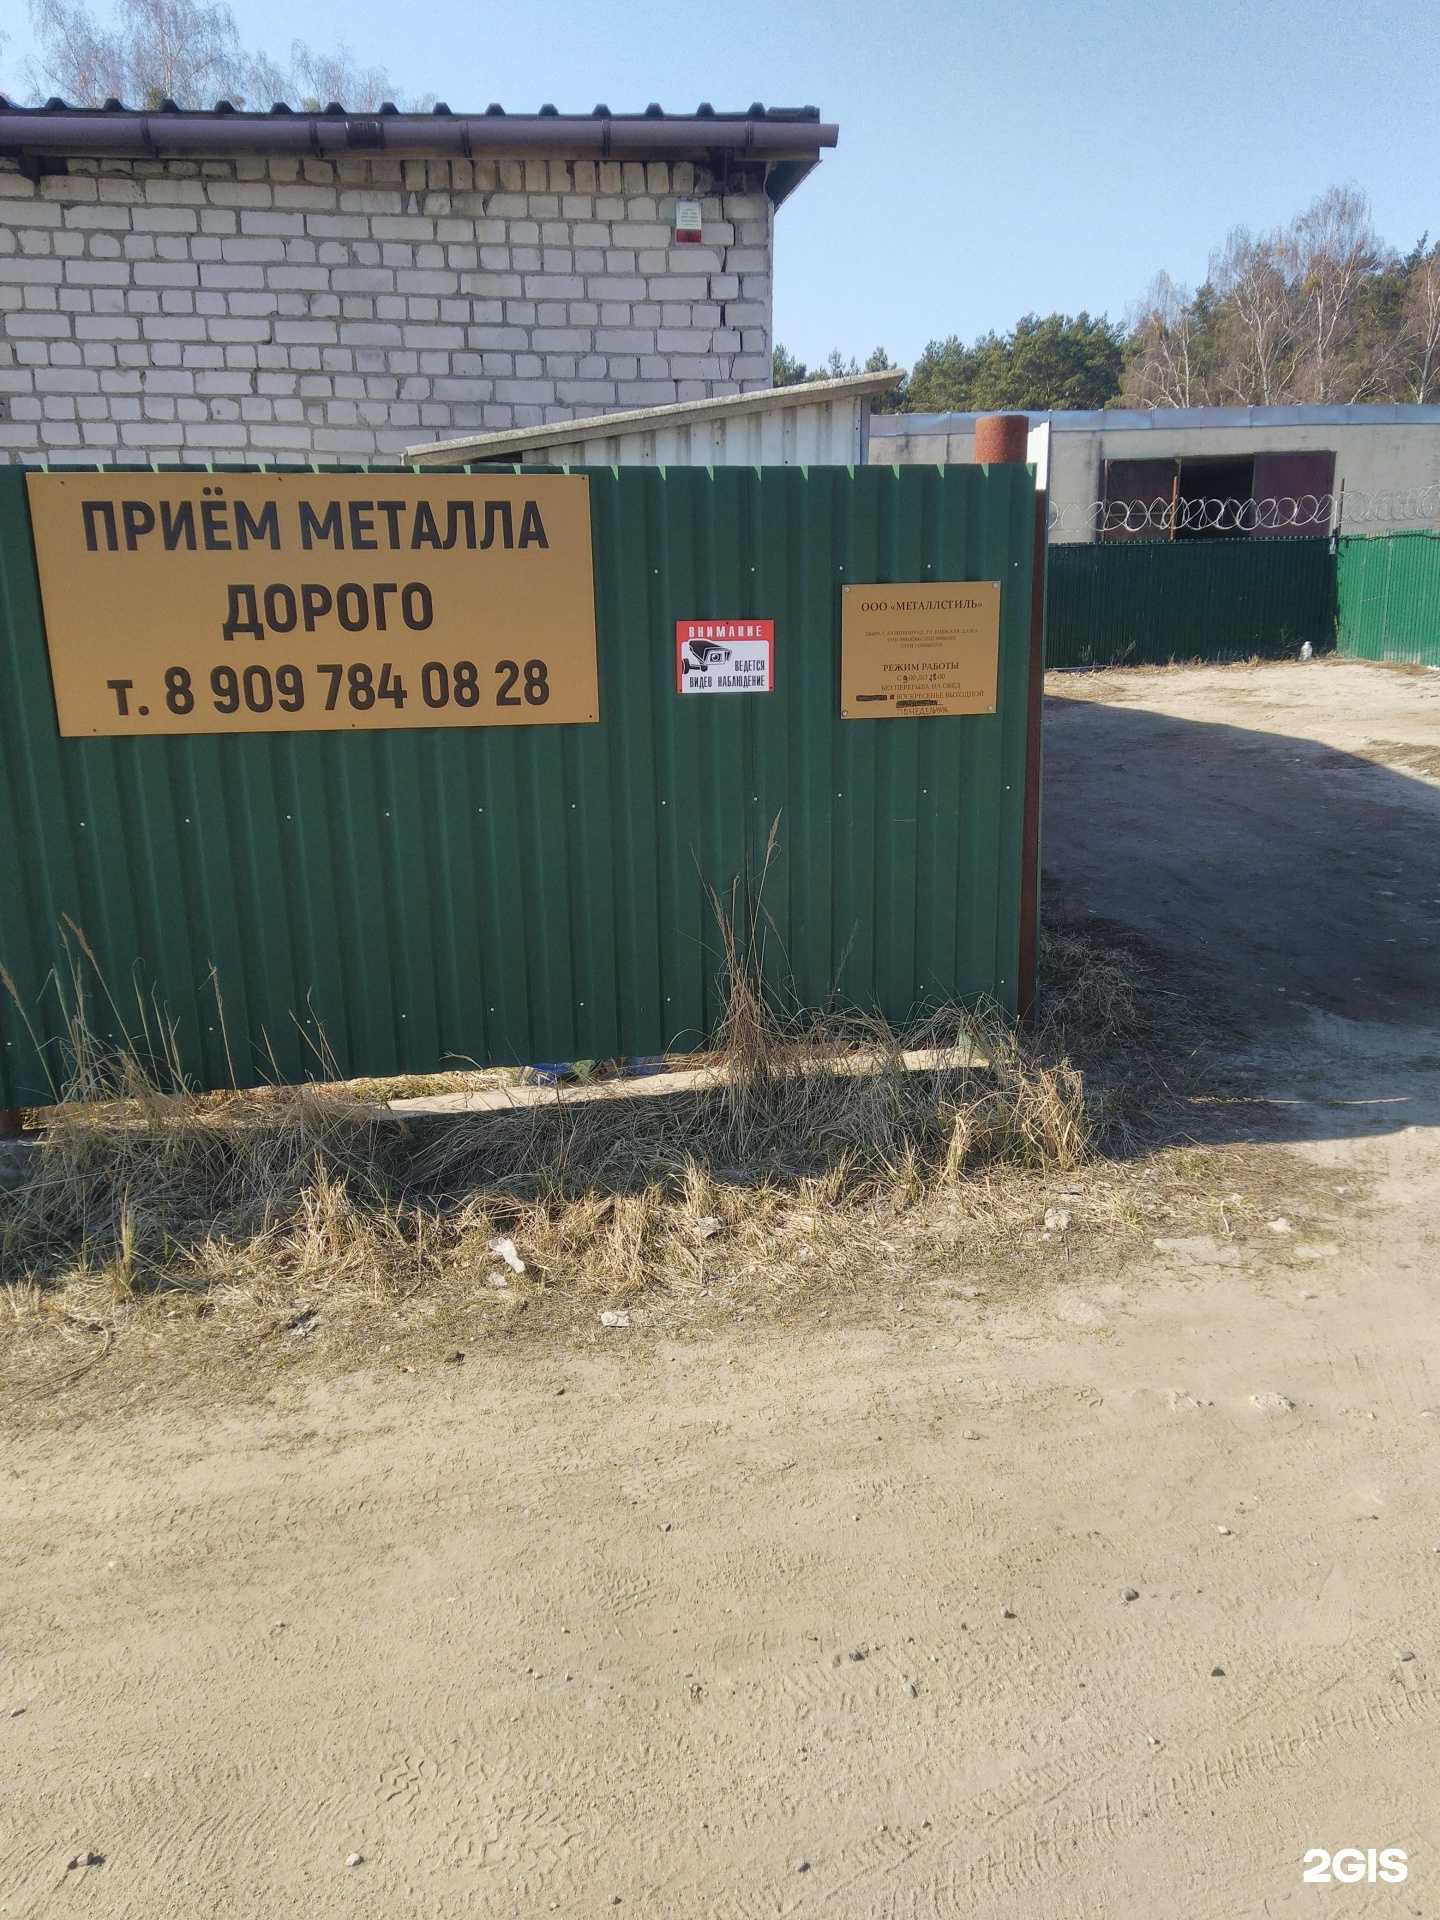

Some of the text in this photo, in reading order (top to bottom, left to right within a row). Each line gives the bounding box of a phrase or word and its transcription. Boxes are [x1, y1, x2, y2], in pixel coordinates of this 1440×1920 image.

[81, 486, 550, 551] ПРИЁМ МЕТАЛЛА
[222, 581, 434, 641] ДОРОГО
[861, 601, 888, 612] ООО
[688, 625, 763, 638] ВНИМАНИЕ
[734, 659, 765, 673] ВЕДЕТСЯ
[882, 661, 960, 672] РЕЖИМ РАБОТЫ
[163, 665, 195, 716] 8
[210, 663, 305, 714] 909
[316, 662, 408, 711] 784
[420, 660, 481, 709] 08
[494, 659, 551, 707] 28
[689, 675, 765, 689] ВИДЕО НАБЛЮДЕНИЕ
